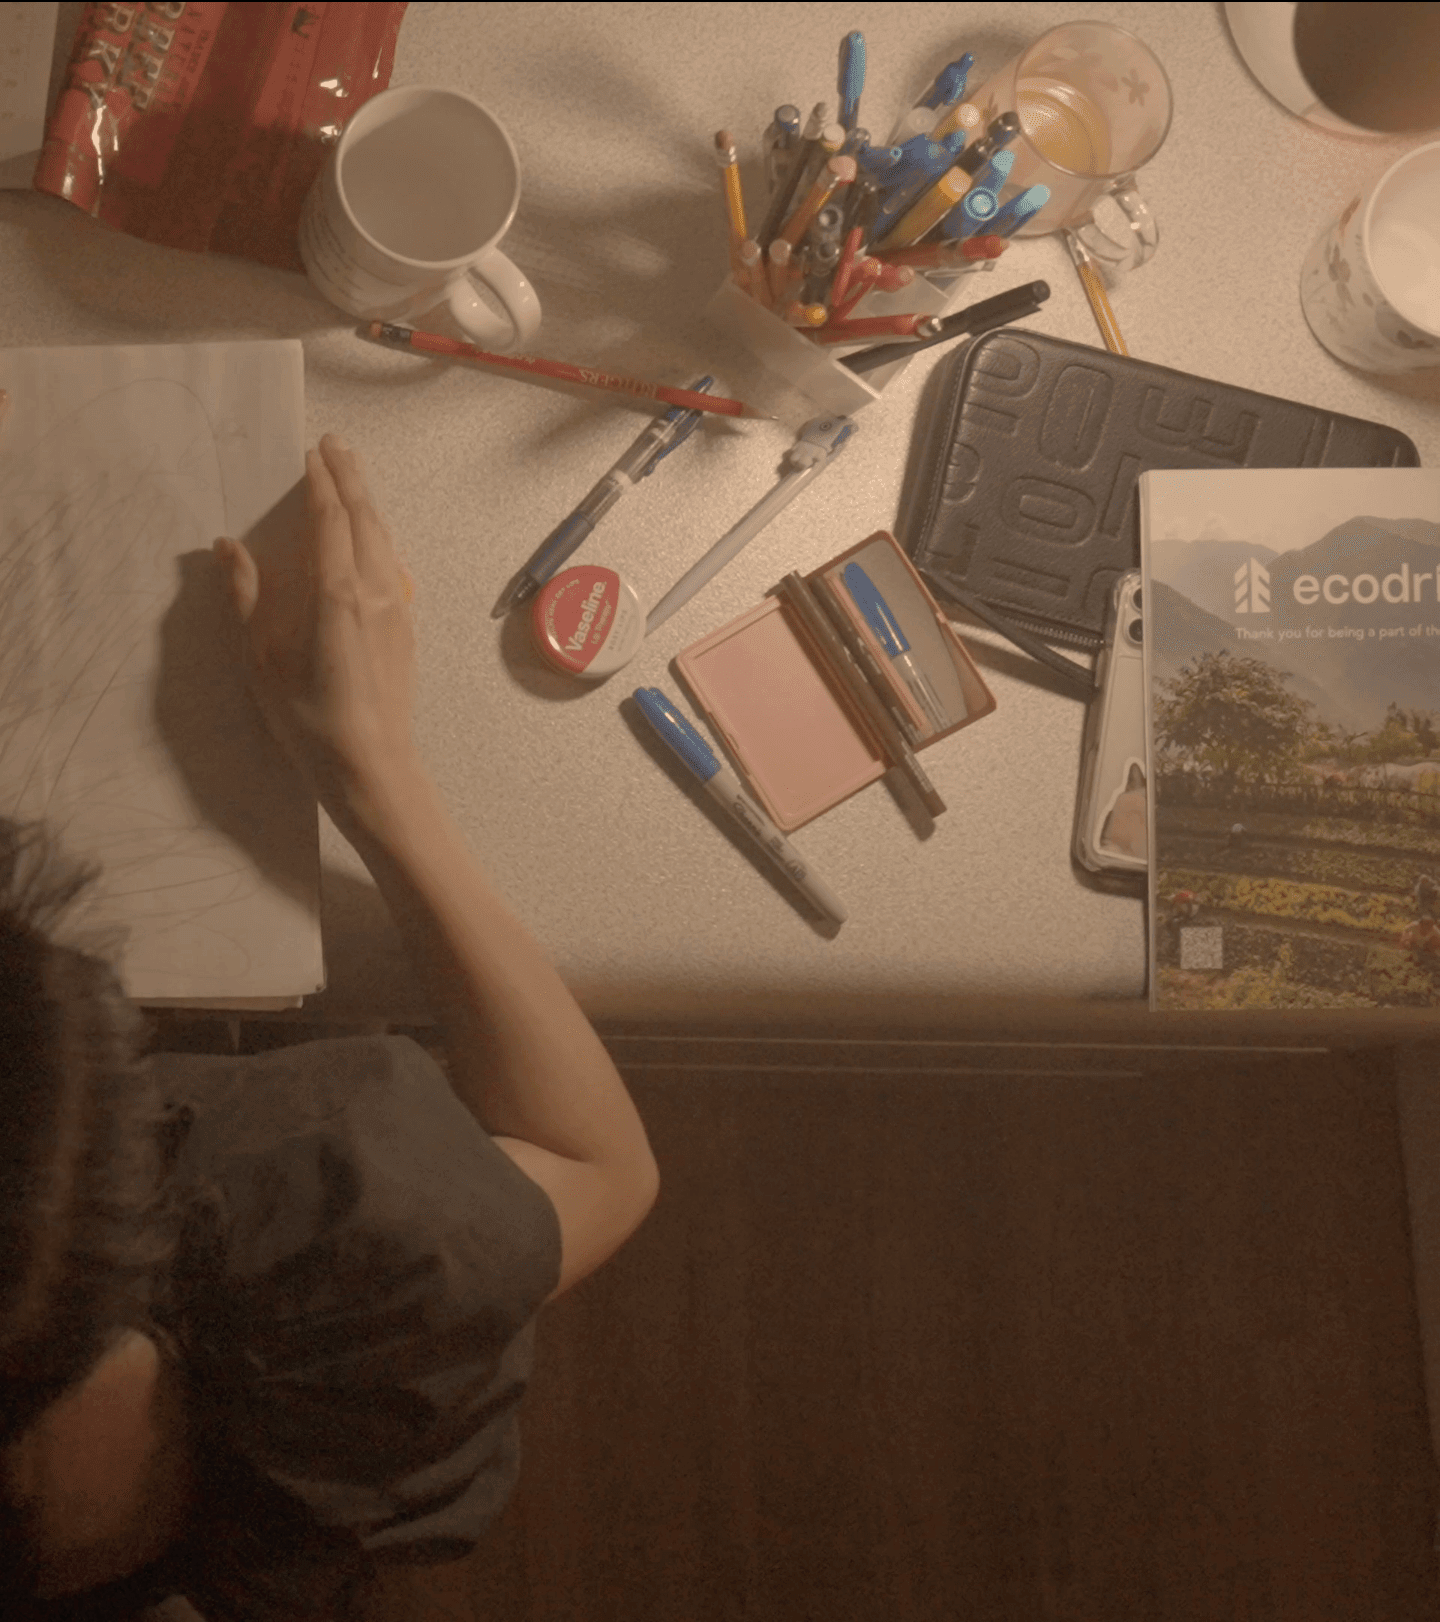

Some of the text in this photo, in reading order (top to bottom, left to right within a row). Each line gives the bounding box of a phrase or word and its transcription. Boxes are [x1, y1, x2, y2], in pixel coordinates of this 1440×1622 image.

[564, 582, 607, 651] Vaseline
[1235, 627, 1274, 640] Thank
[1278, 630, 1302, 642] you
[1306, 626, 1325, 639] for
[1328, 625, 1364, 641] being
[1368, 628, 1376, 638] a
[1379, 626, 1405, 640] part
[1409, 623, 1422, 637] of
